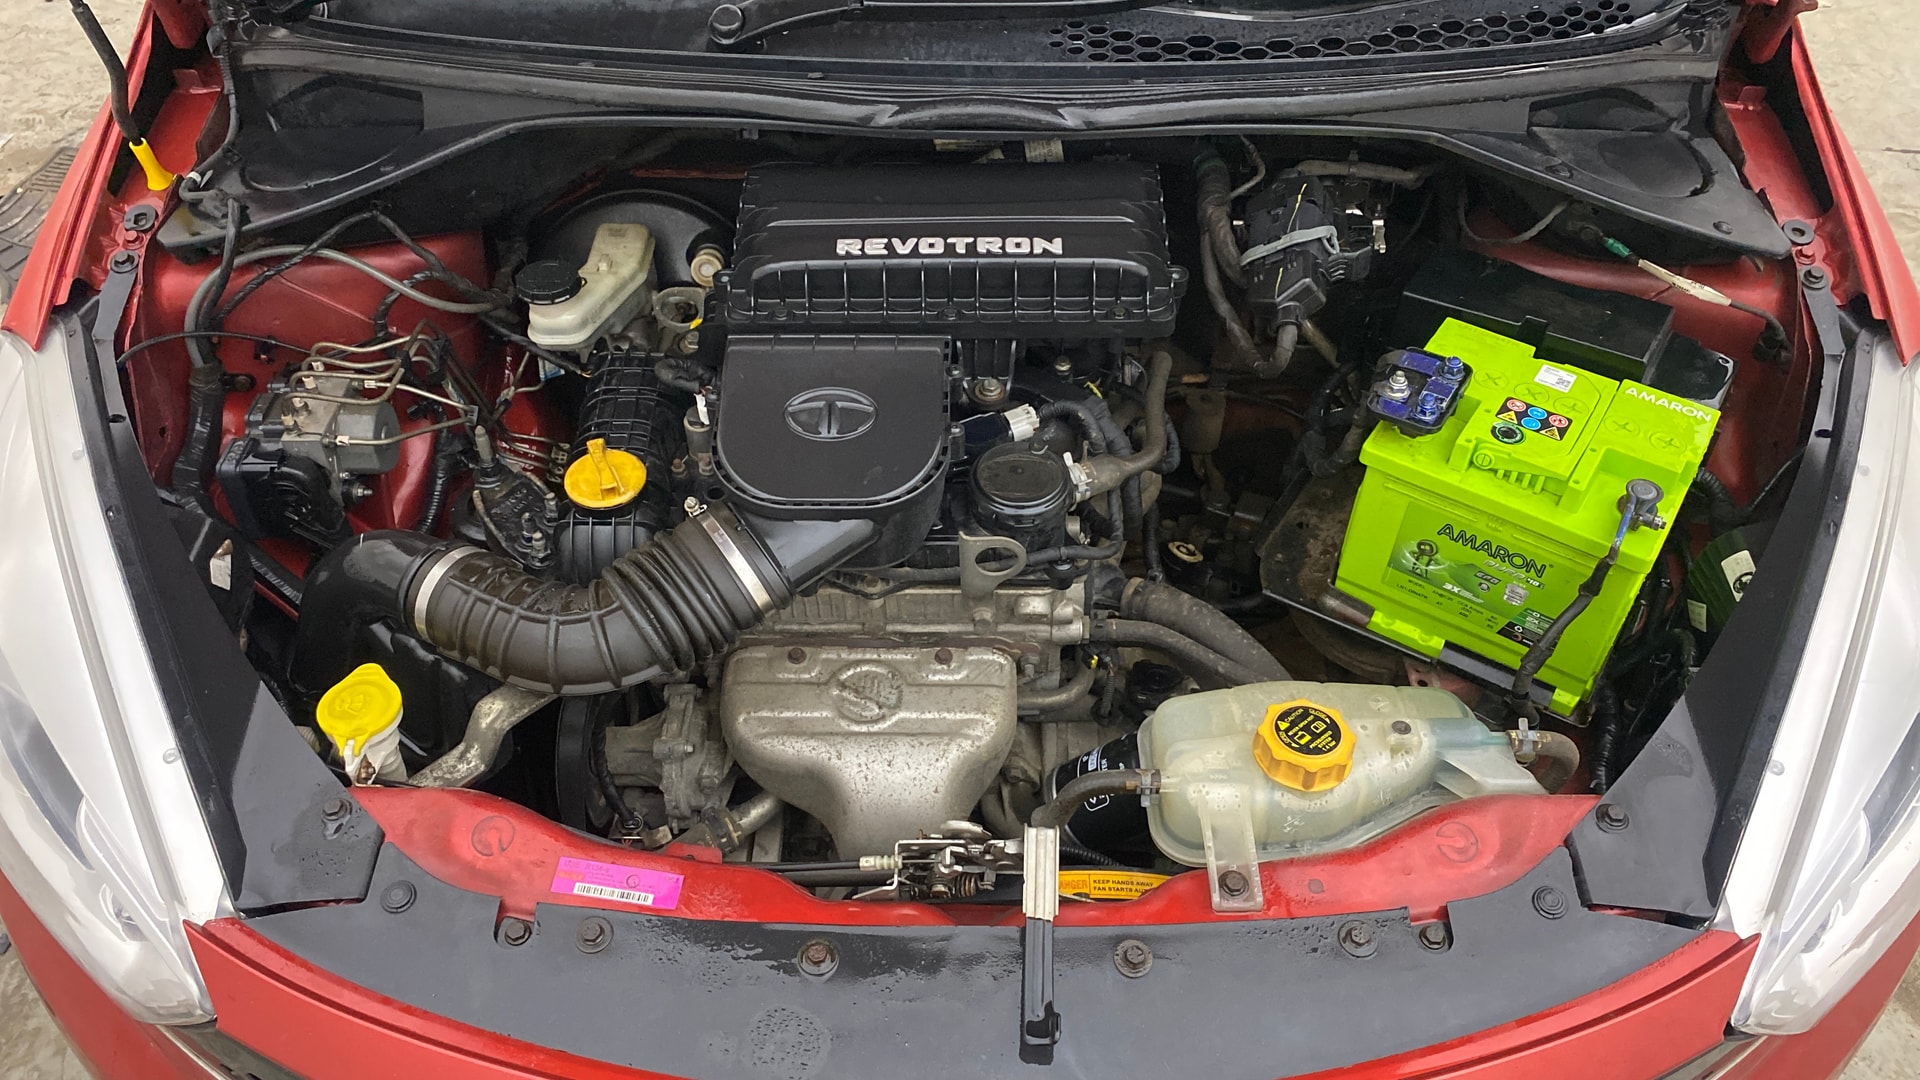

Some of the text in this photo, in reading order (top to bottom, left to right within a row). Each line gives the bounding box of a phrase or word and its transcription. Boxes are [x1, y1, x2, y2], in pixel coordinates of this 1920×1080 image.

[836, 237, 1063, 256] REVOTRON
[1625, 387, 1712, 422] AMARON
[1437, 523, 1547, 578] AMARON
[1059, 880, 1088, 890] ANGER
